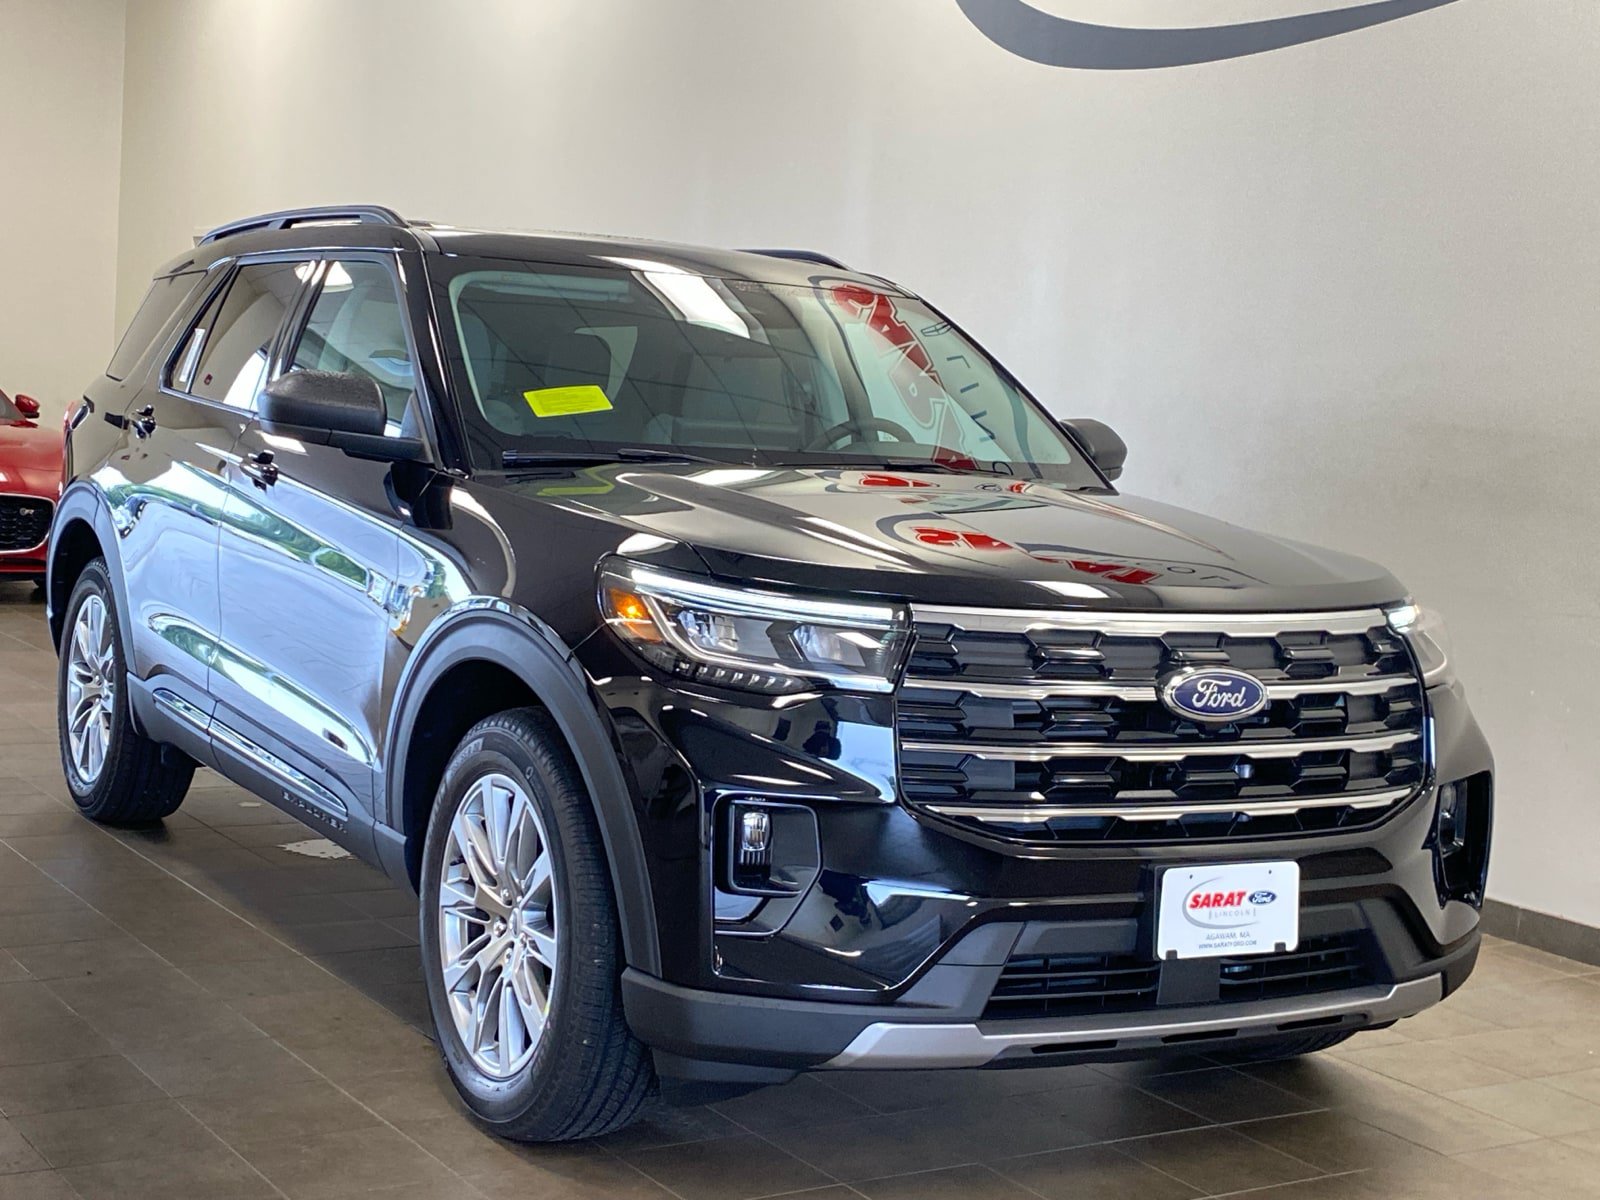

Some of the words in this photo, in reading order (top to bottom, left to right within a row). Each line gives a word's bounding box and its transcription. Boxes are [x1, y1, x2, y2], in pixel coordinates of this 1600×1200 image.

[1192, 679, 1246, 708] Ford
[1189, 891, 1247, 909] SARAT
[1214, 910, 1251, 918] LINCOLN
